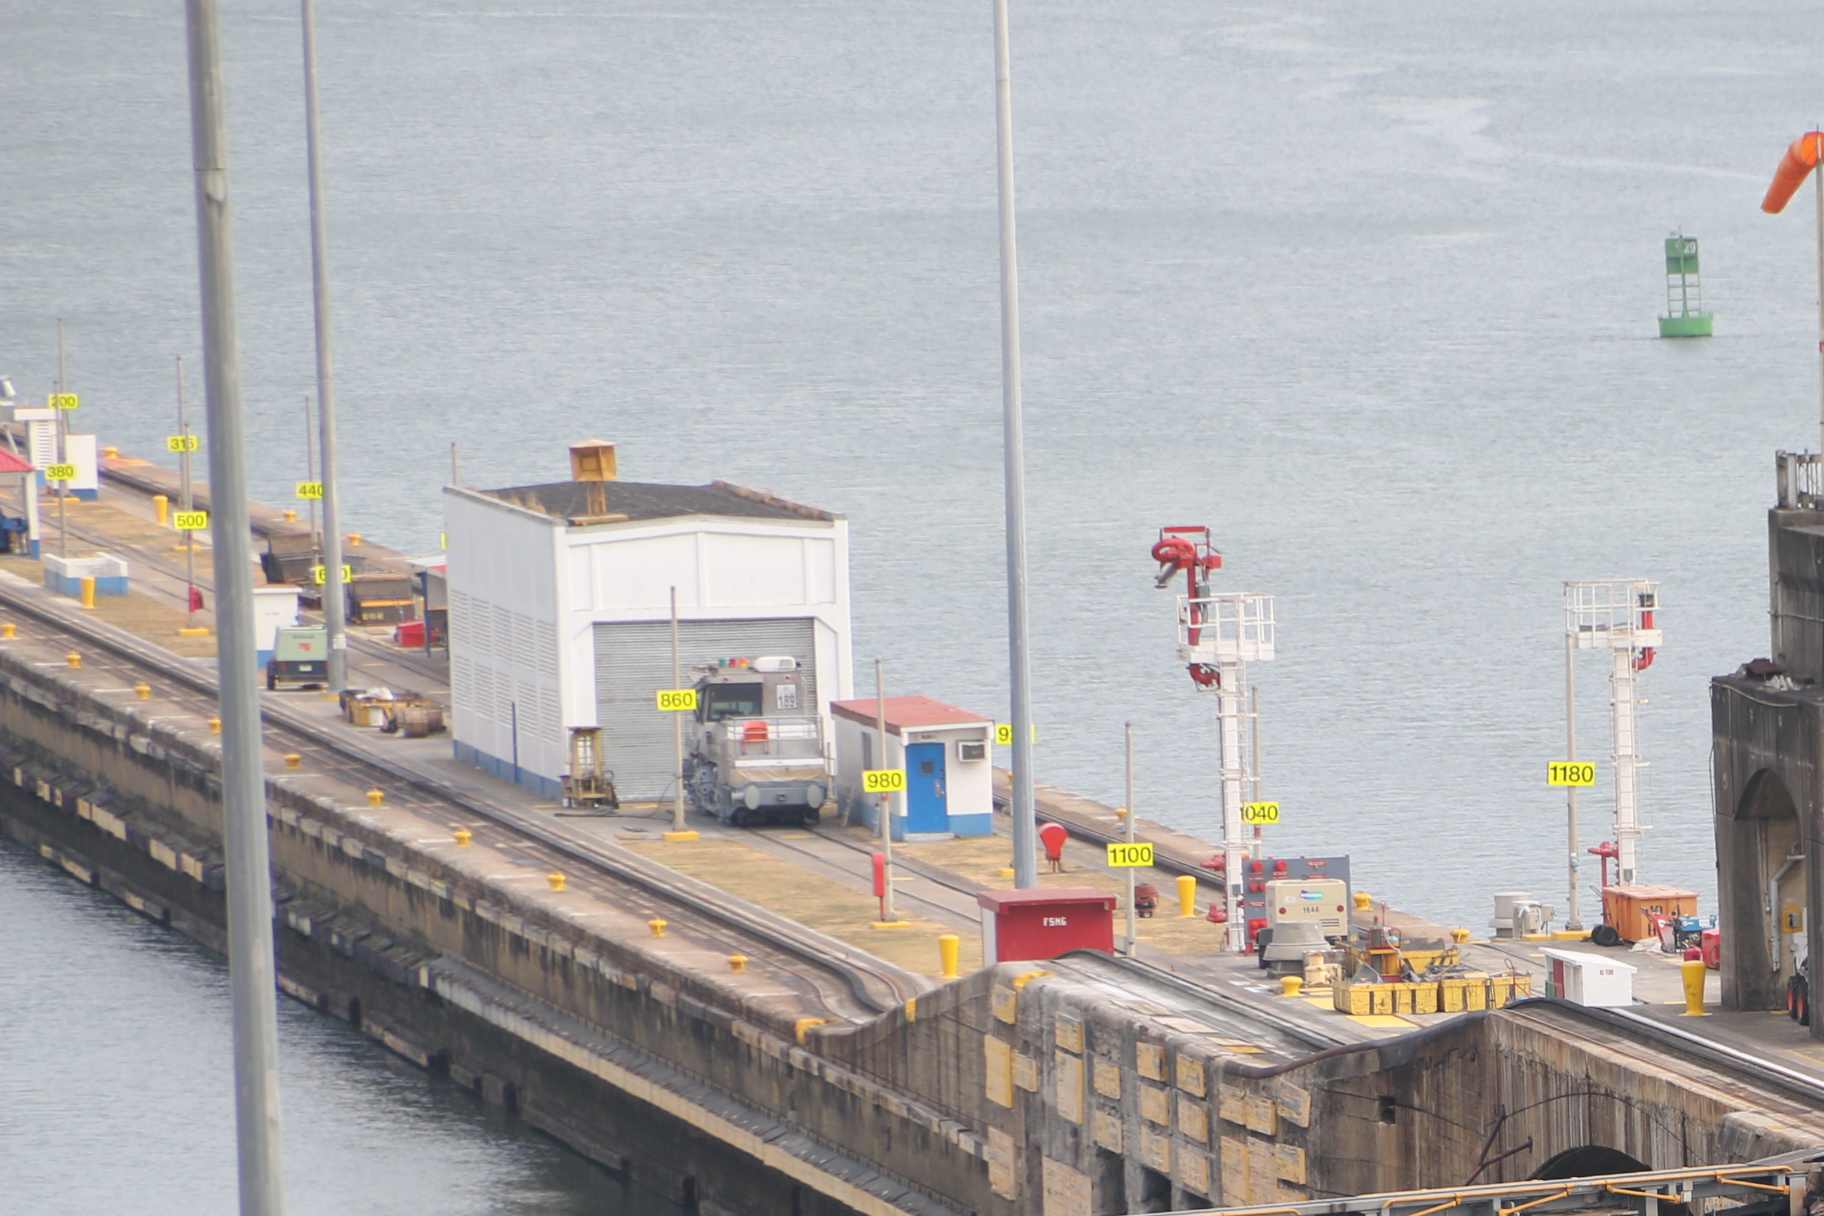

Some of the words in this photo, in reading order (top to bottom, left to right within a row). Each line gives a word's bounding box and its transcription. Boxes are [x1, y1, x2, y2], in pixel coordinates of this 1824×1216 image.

[48, 466, 73, 478] 380
[177, 514, 204, 527] 500
[660, 692, 693, 708] 860
[867, 772, 902, 788] 980
[1550, 766, 1594, 783] 1180
[1109, 847, 1152, 864] 1100
